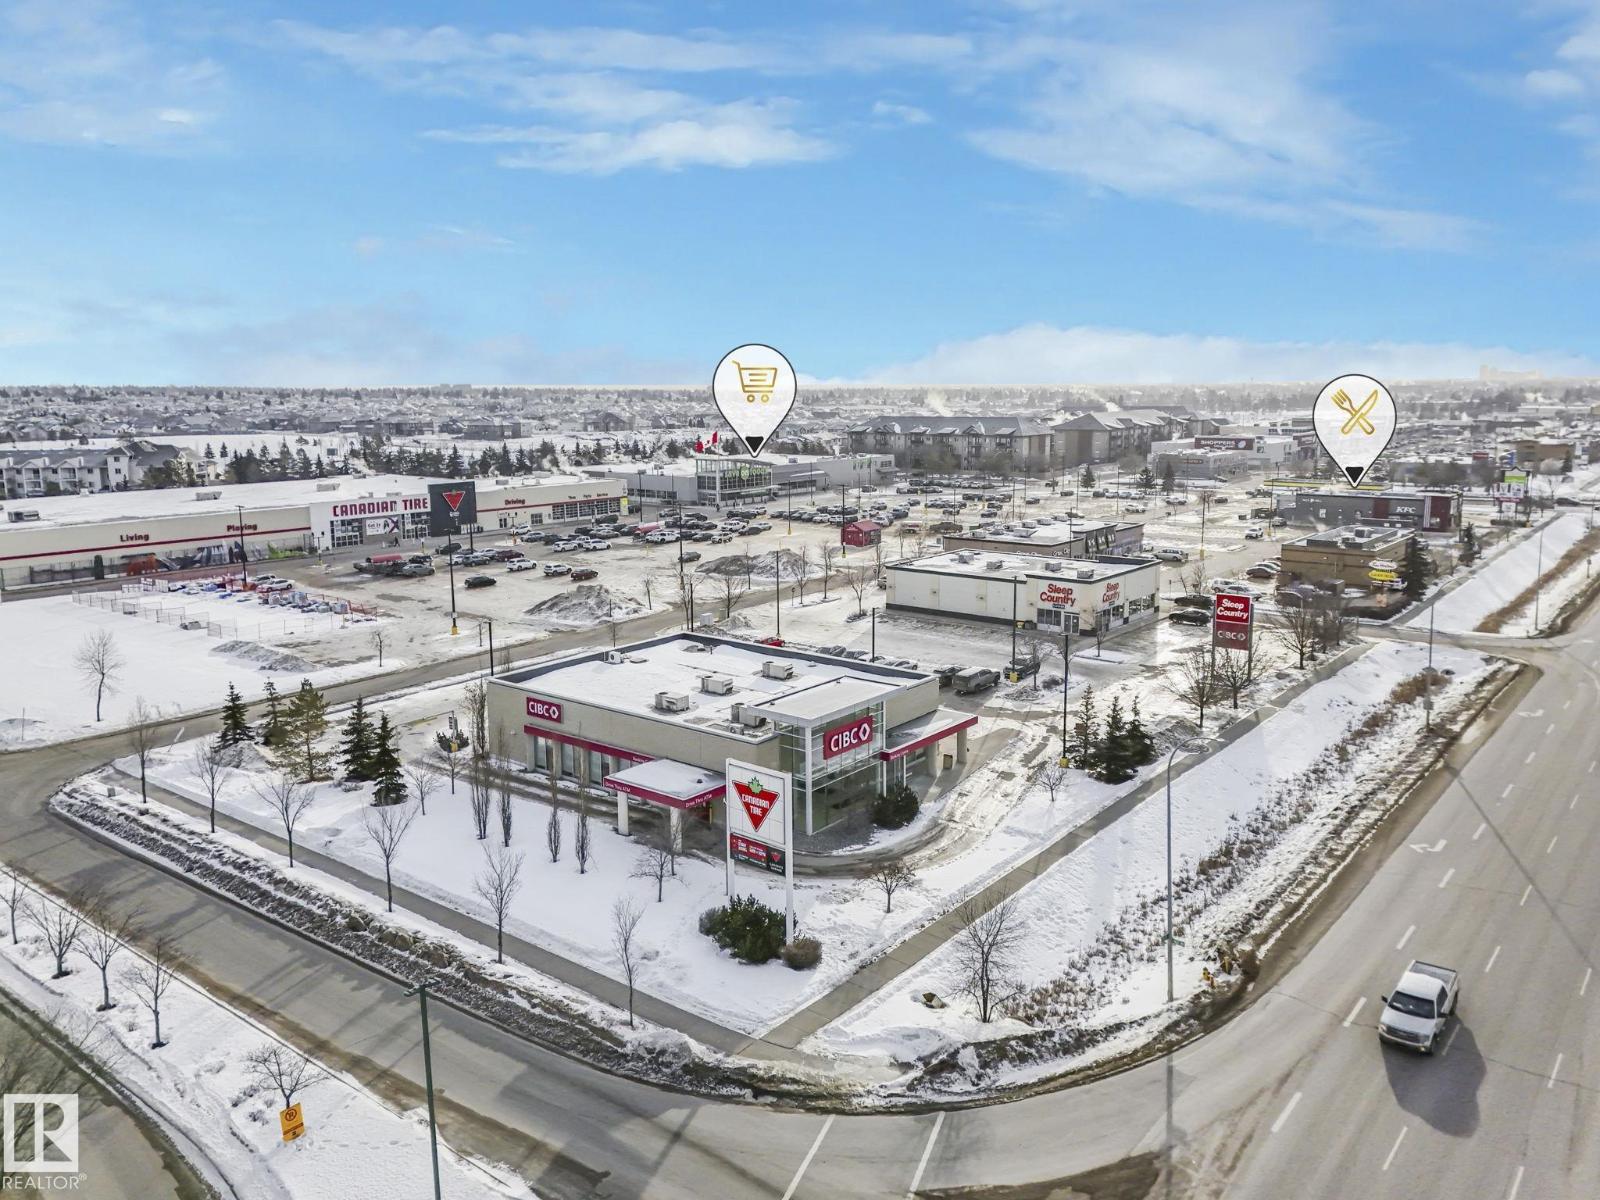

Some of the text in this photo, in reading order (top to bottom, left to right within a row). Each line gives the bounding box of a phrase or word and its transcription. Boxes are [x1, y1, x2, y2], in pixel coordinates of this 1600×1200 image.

[332, 497, 428, 517] CANADIAN TIRE
[1396, 506, 1417, 514] KFC
[120, 533, 150, 542] Living
[1047, 583, 1073, 597] Sleep
[1106, 582, 1119, 593] Sleep
[1039, 592, 1077, 607] Country
[1102, 591, 1121, 603] Country
[1221, 598, 1245, 610] Sleep
[1217, 606, 1249, 620] Country
[1217, 630, 1237, 640] CBC
[528, 701, 549, 717] CIBC
[830, 727, 858, 752] CIBC
[741, 793, 770, 809] CANADIAN
[749, 805, 763, 817] TIRE
